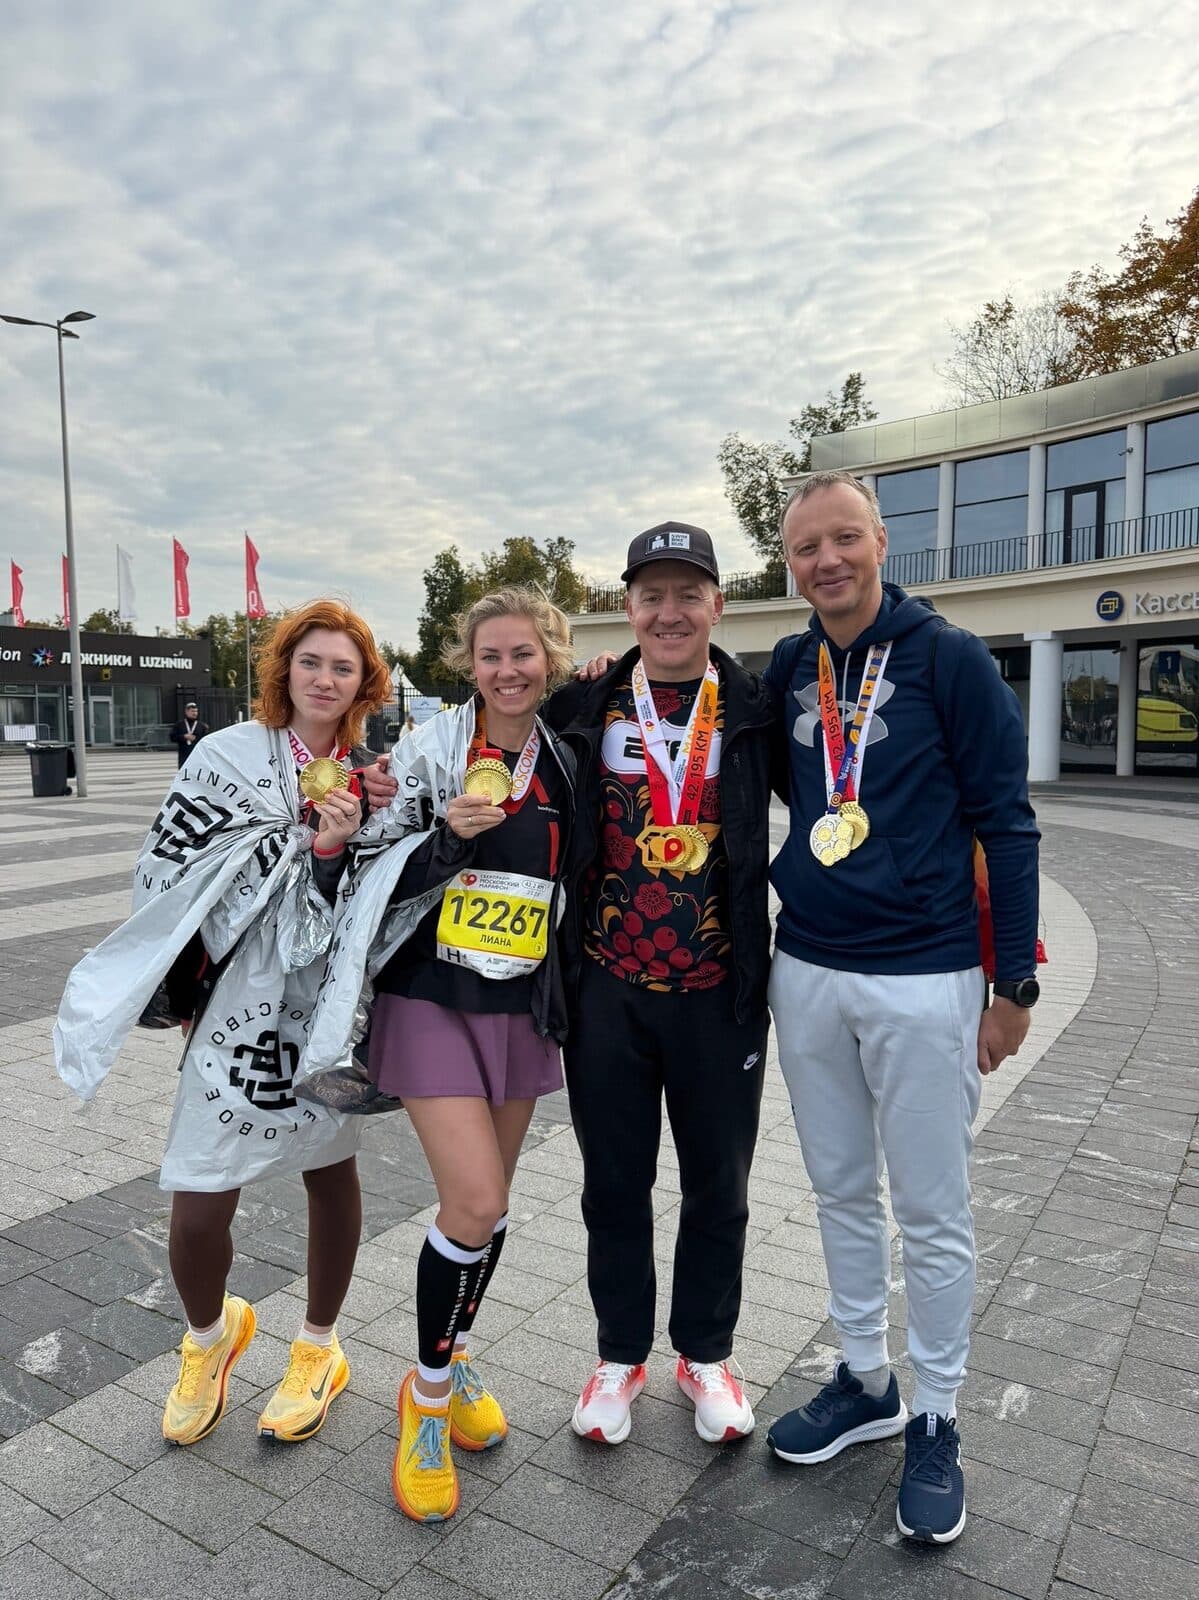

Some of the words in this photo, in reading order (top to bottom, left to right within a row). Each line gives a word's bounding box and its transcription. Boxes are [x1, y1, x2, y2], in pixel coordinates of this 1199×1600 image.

[61, 652, 132, 667] ЛЖНИКИ
[139, 656, 192, 669] LUZHNIKI
[1166, 657, 1171, 669] 1
[695, 730, 710, 752] KM
[686, 753, 705, 802] 42.195
[450, 895, 546, 939] 12267
[480, 934, 512, 947] ЛИАНА
